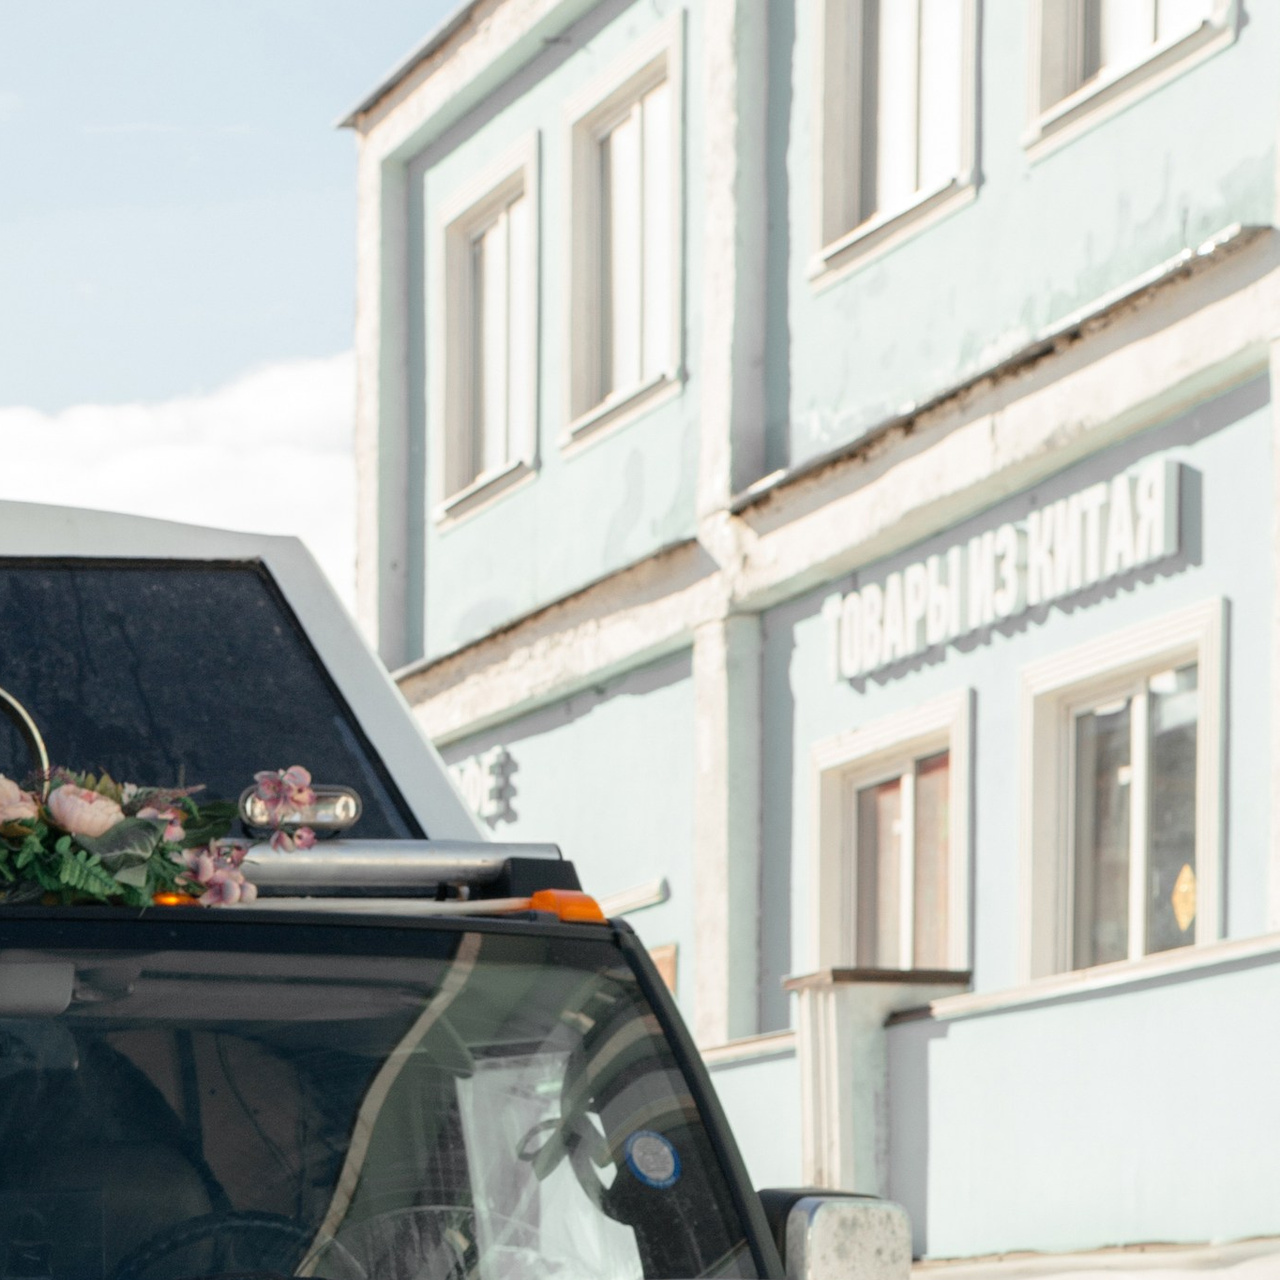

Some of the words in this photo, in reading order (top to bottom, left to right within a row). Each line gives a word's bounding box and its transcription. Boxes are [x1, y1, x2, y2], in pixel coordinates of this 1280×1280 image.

[821, 545, 962, 683] ТОВАРЫ
[967, 522, 1021, 629] ИЗ
[1026, 456, 1168, 607] КИТАЯ
